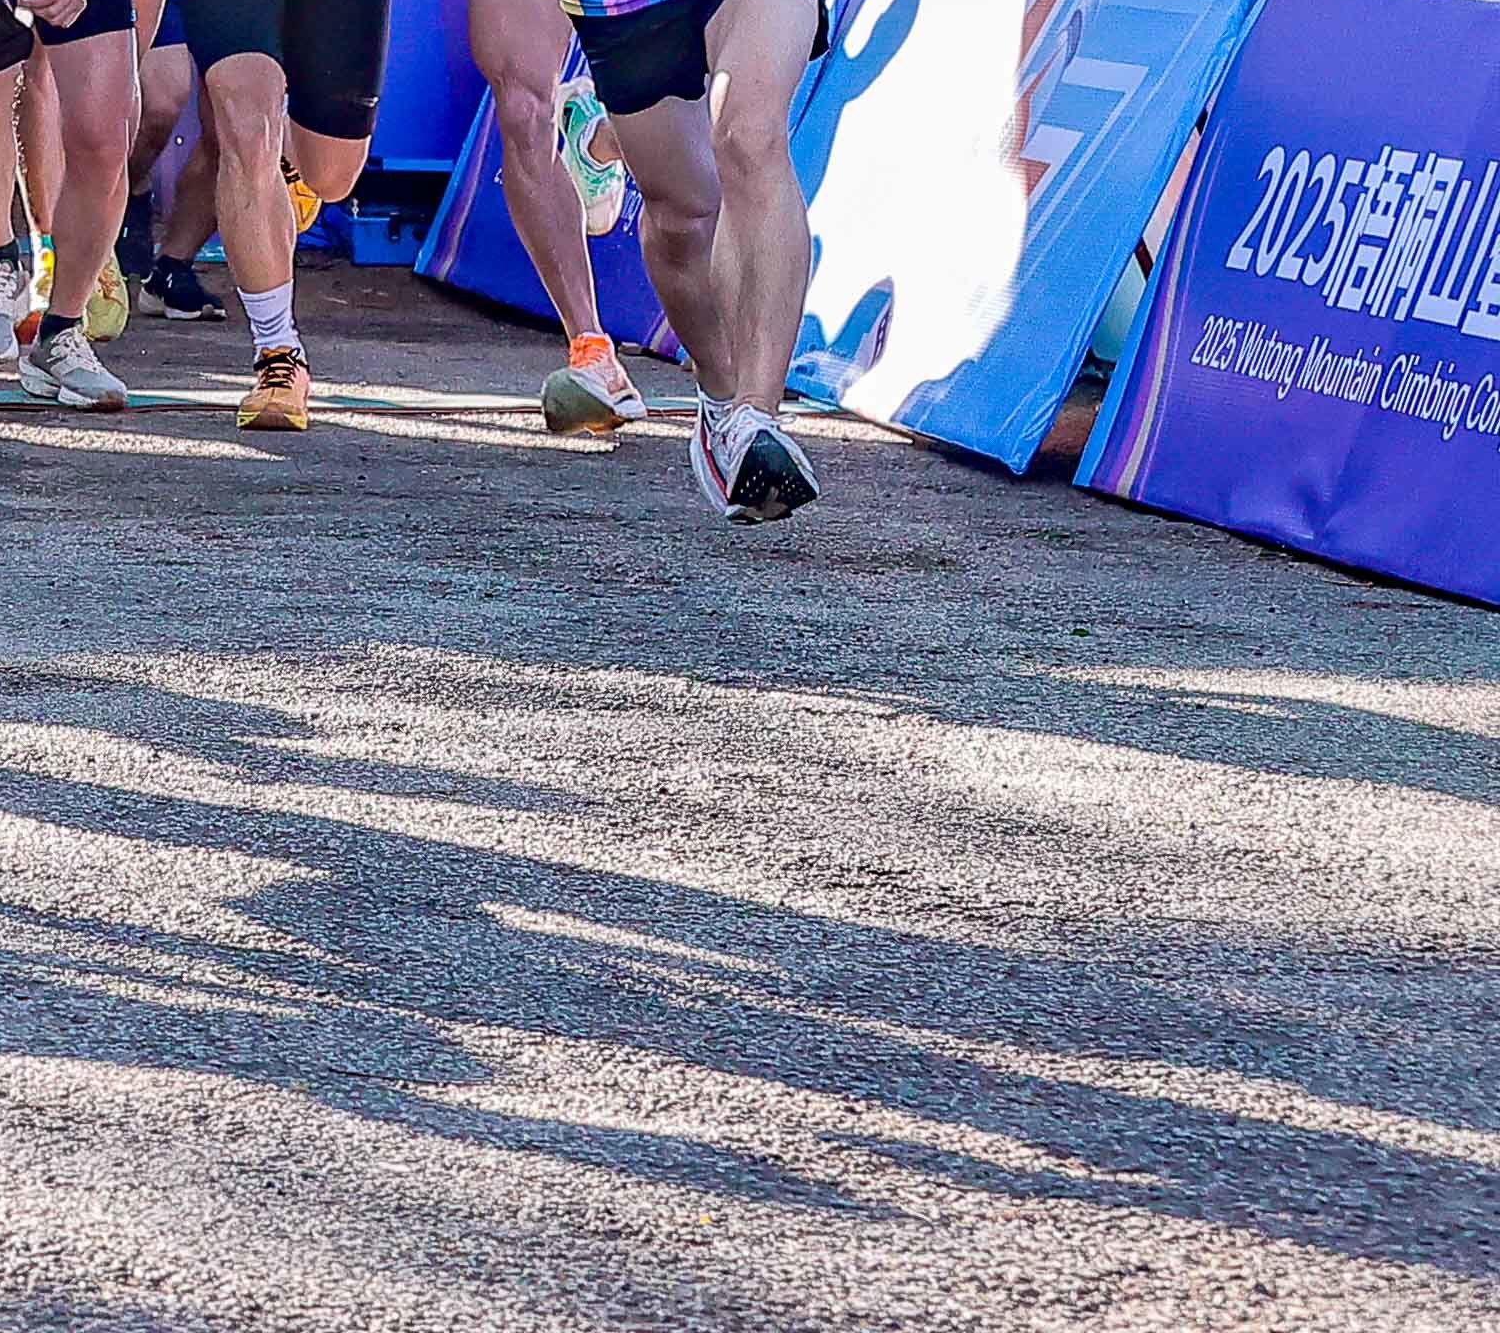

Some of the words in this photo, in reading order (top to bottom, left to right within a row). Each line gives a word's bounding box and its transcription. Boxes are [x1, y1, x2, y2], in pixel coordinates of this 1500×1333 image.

[1190, 315, 1240, 370] 2025
[1237, 319, 1305, 400] Wutong
[1297, 335, 1383, 405] Mountain
[1381, 353, 1460, 441] Climbing
